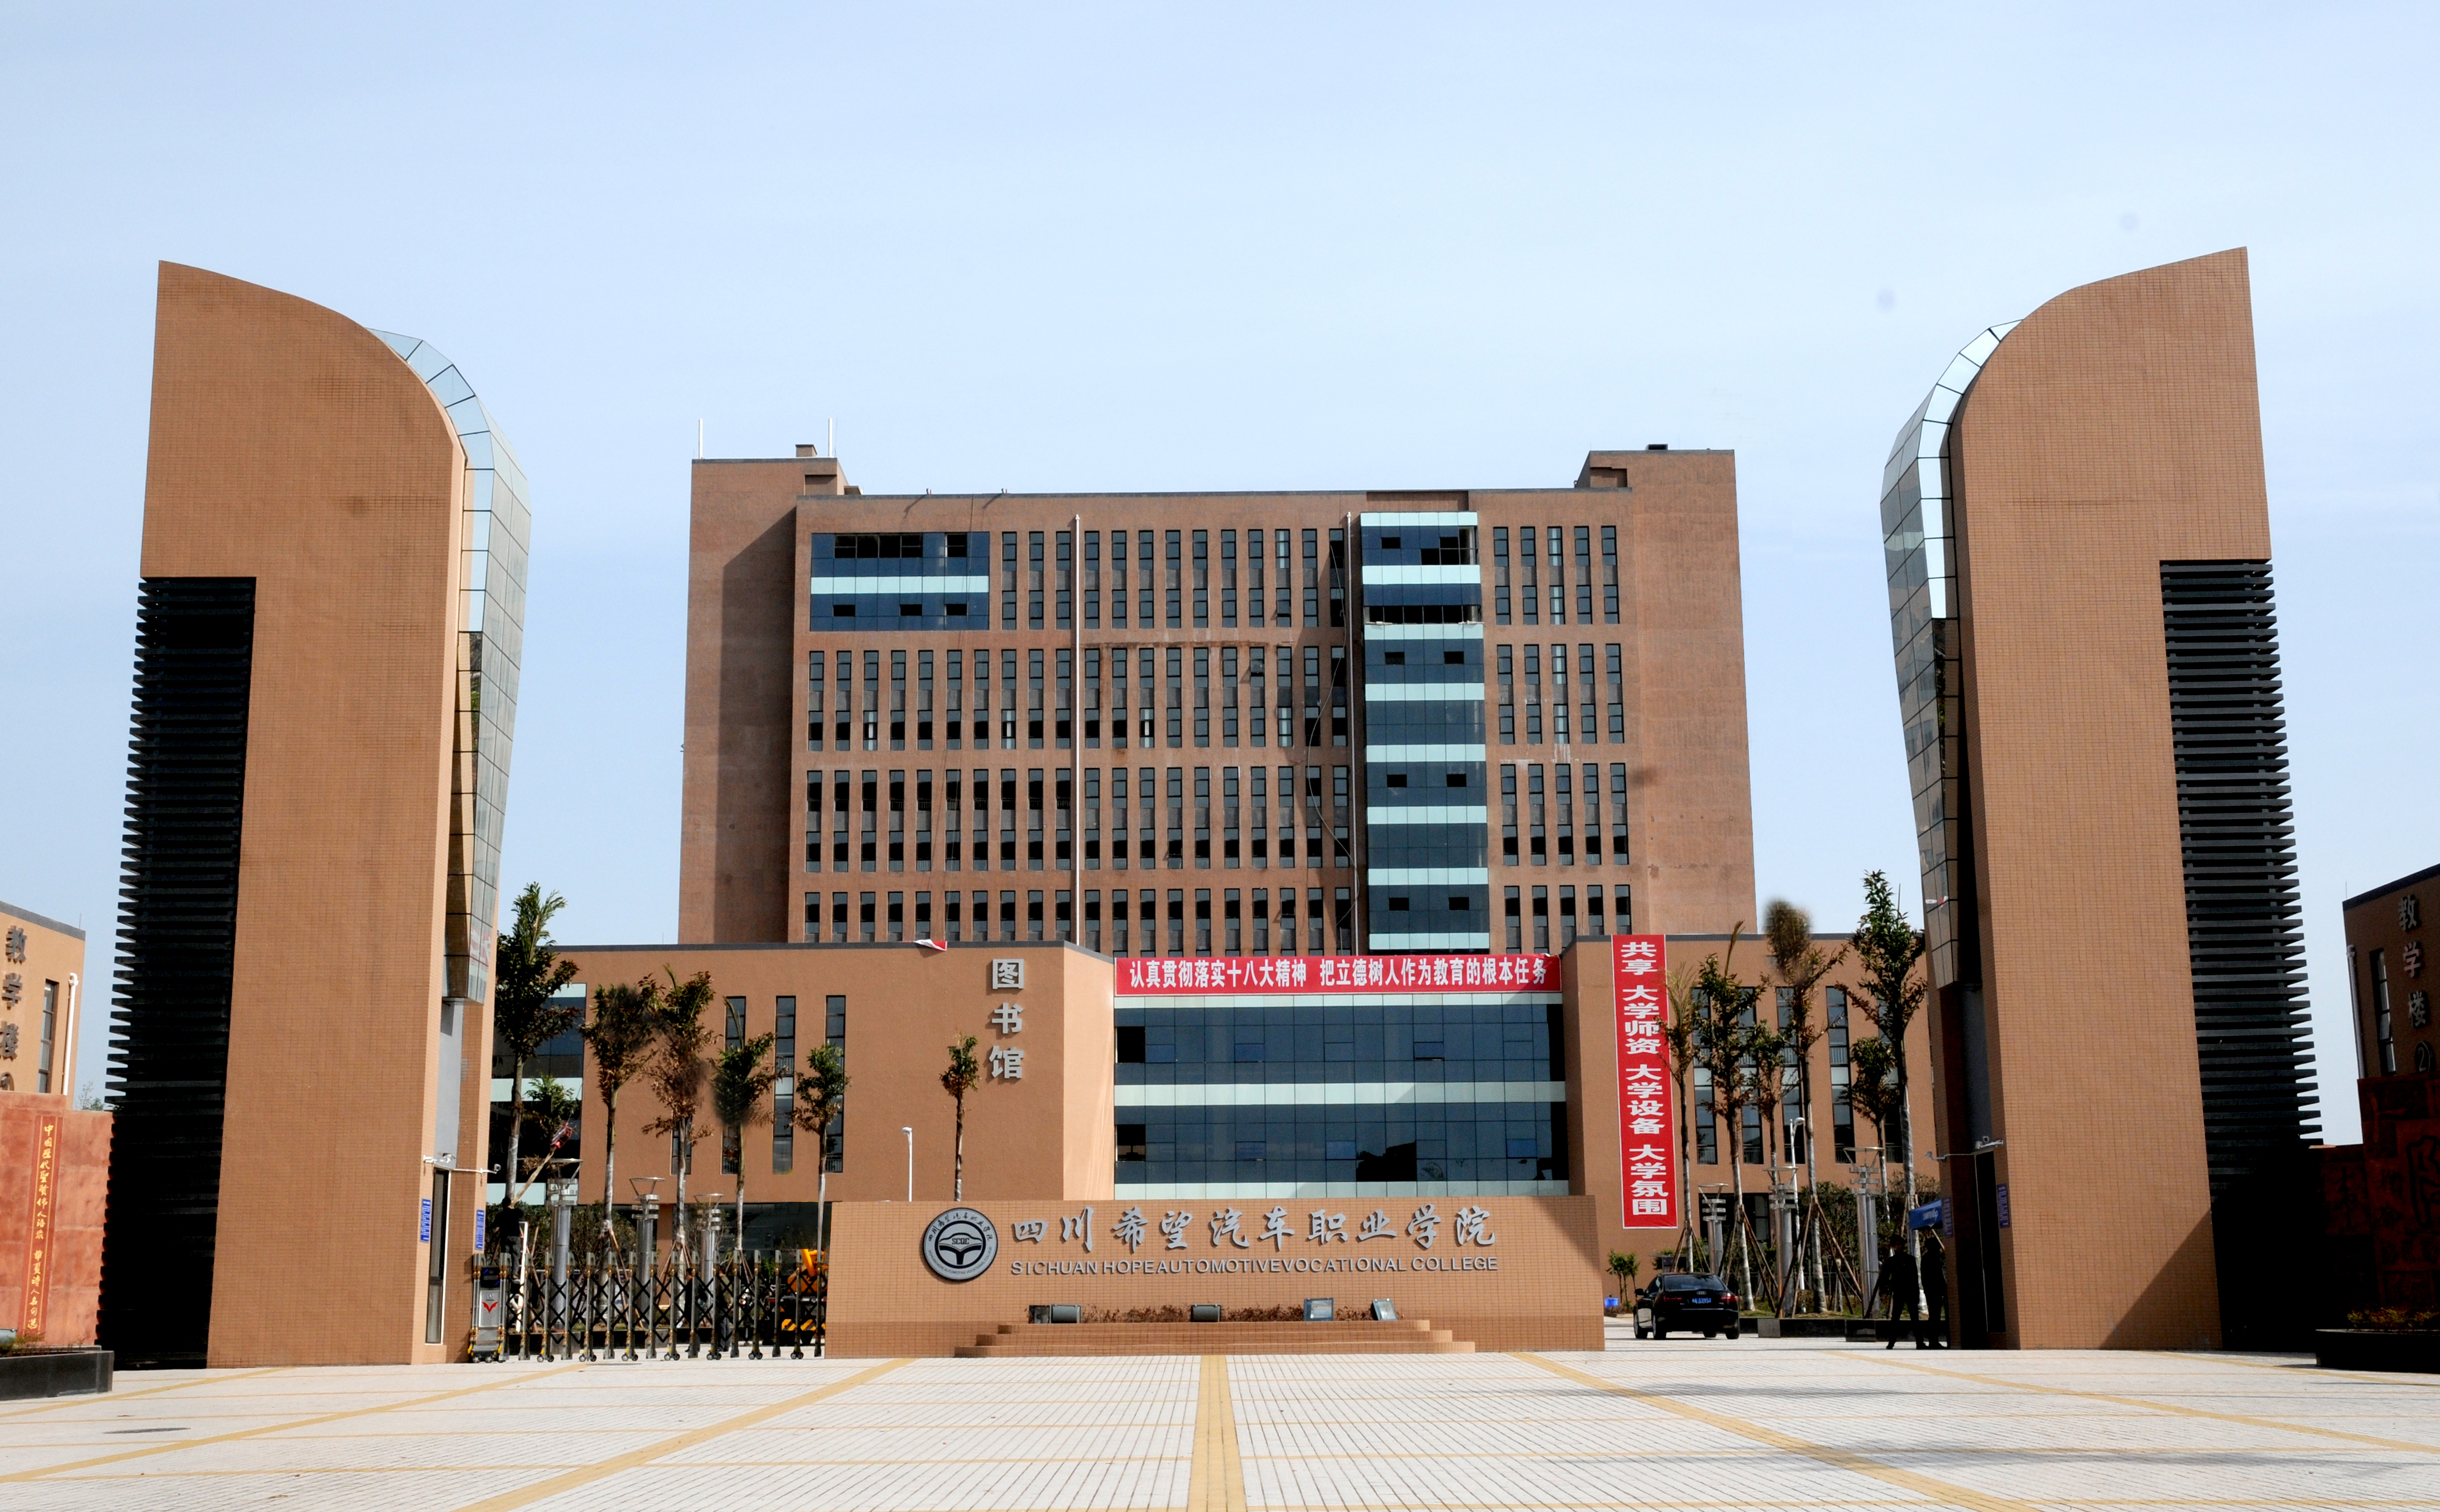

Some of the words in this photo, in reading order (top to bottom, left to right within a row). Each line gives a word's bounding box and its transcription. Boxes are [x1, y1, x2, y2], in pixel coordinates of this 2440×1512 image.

[1130, 959, 1306, 988] 认真贯彻落实十八大精神
[1319, 957, 1547, 986] 把立德树人作为教育的根本任务
[1621, 942, 1658, 976] 共享
[989, 958, 1024, 1079] 图书馆
[1622, 984, 1662, 1055] 大学师资
[1625, 1064, 1665, 1135] 大学设备
[1629, 1144, 1669, 1215] 大学氛围
[1014, 1203, 1496, 1253] 四川希望汽车职业学院
